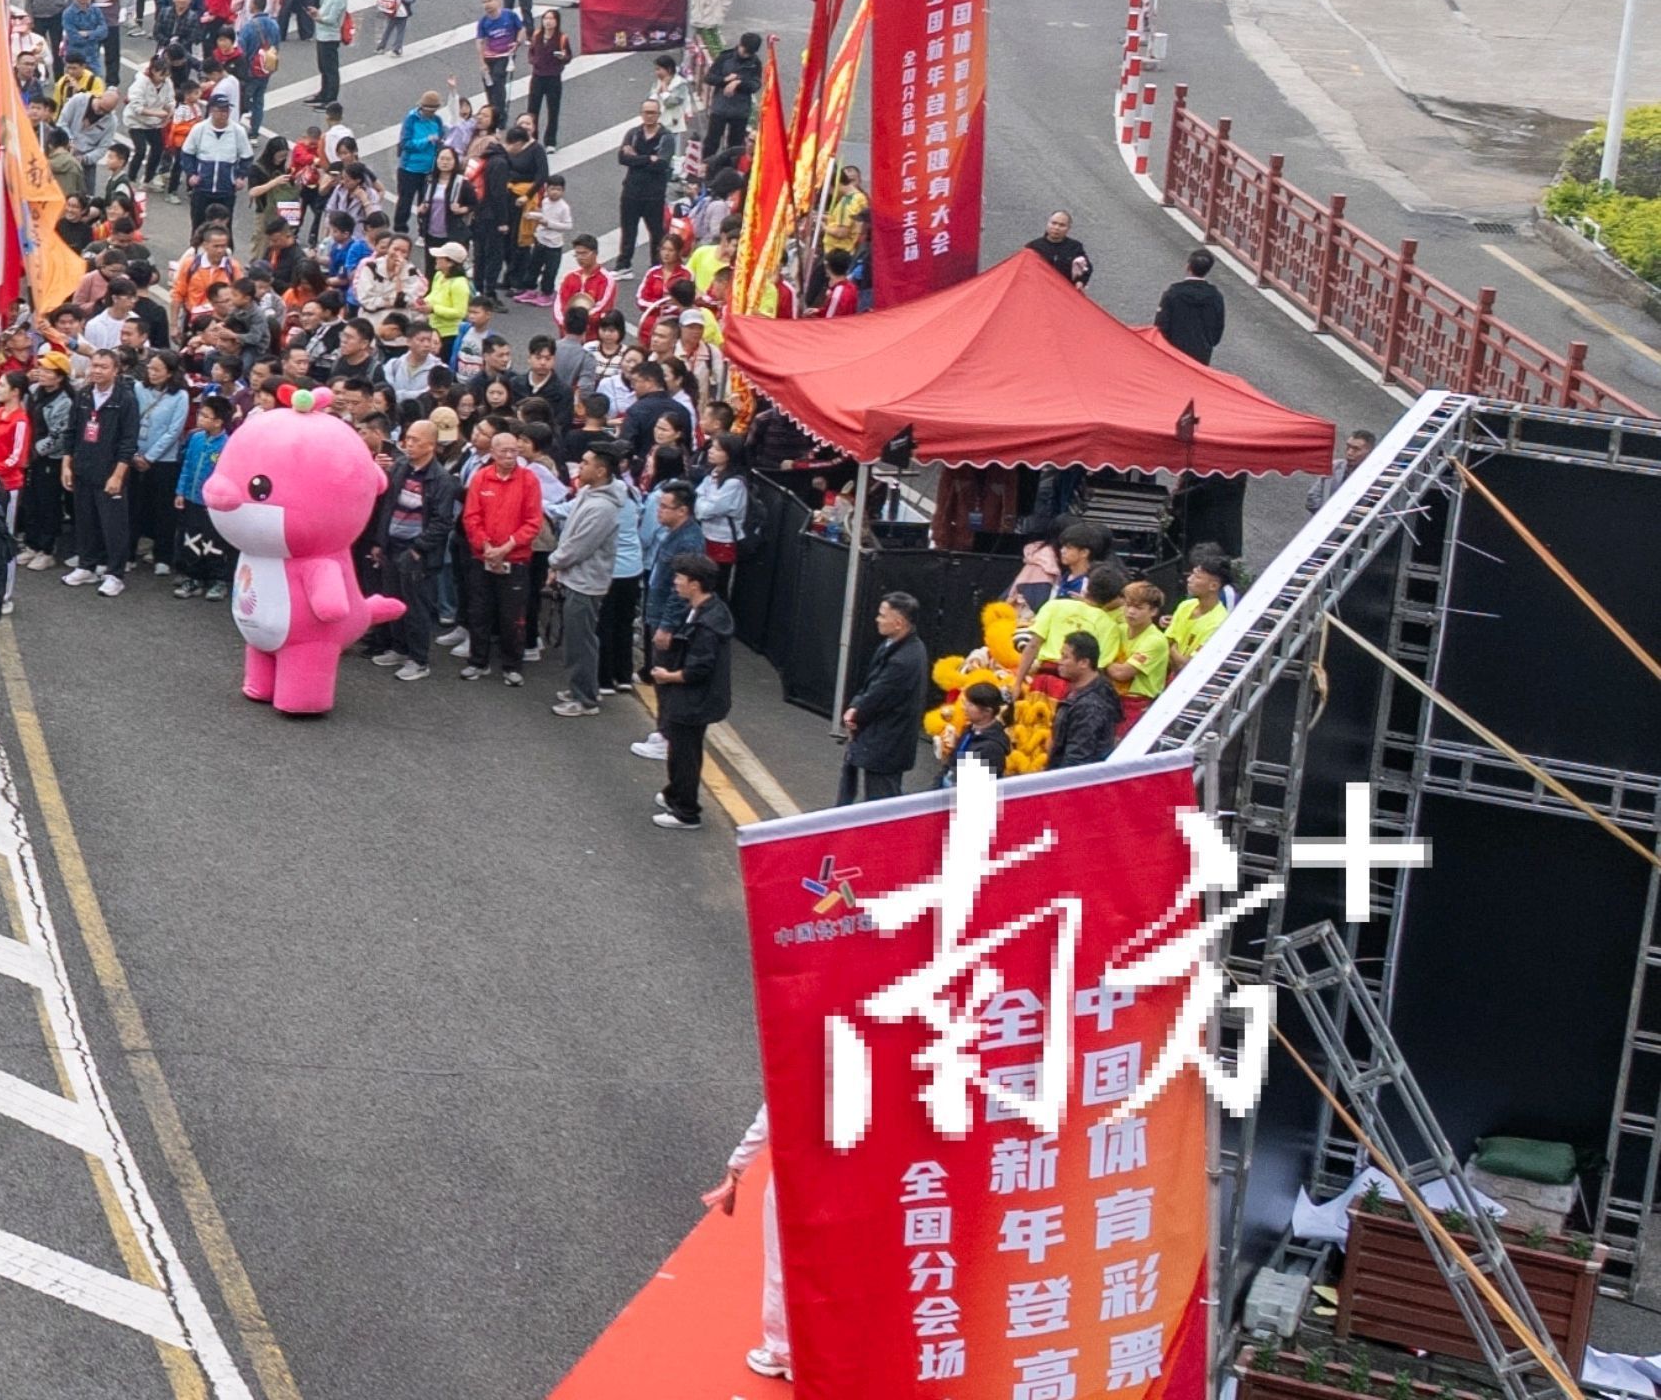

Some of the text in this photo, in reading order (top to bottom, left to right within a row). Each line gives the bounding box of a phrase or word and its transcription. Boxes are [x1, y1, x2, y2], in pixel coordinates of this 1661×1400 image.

[774, 913, 873, 948] 中国体育彩
[978, 989, 1078, 1400] 全国新年登高
[1075, 978, 1165, 1391] 中国体育彩票
